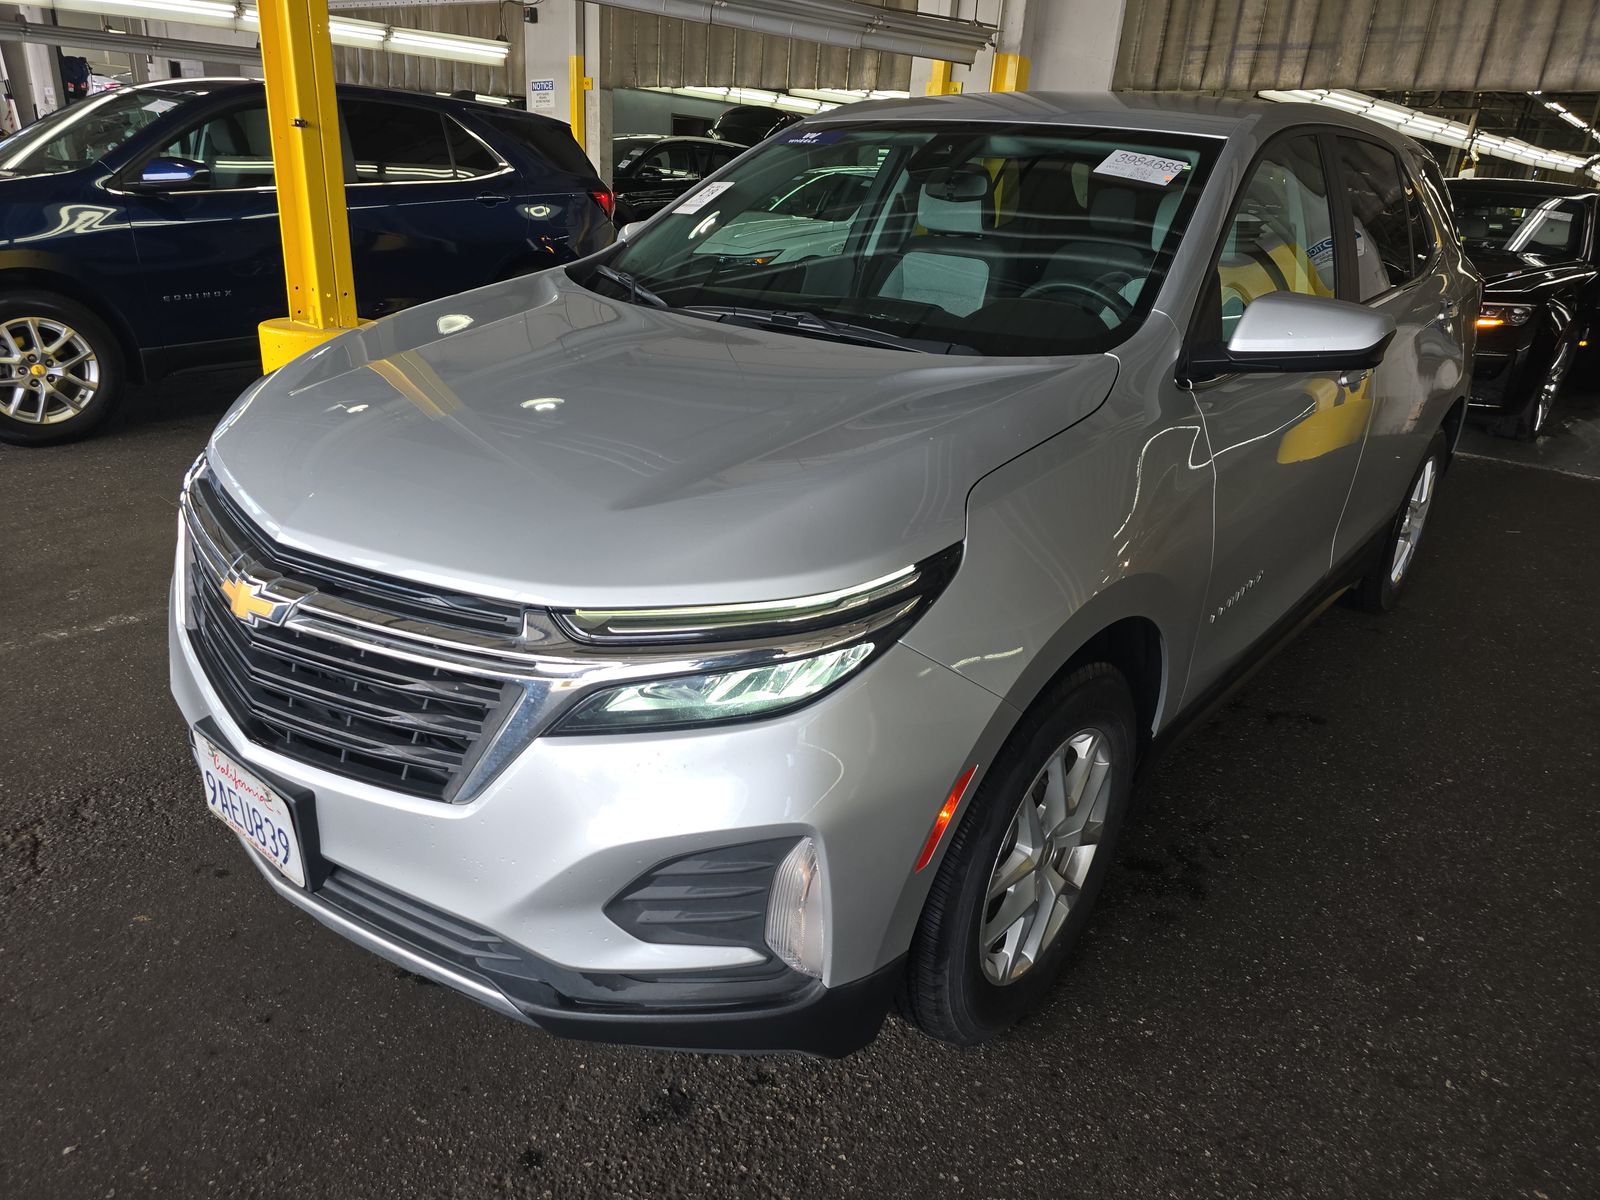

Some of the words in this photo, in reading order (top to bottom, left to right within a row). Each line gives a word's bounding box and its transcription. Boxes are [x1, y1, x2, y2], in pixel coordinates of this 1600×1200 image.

[532, 82, 553, 91] NOTICE
[1114, 153, 1184, 173] 3984689
[162, 290, 232, 302] EQUINOX
[213, 754, 271, 809] California
[206, 770, 290, 865] 9AEU839
